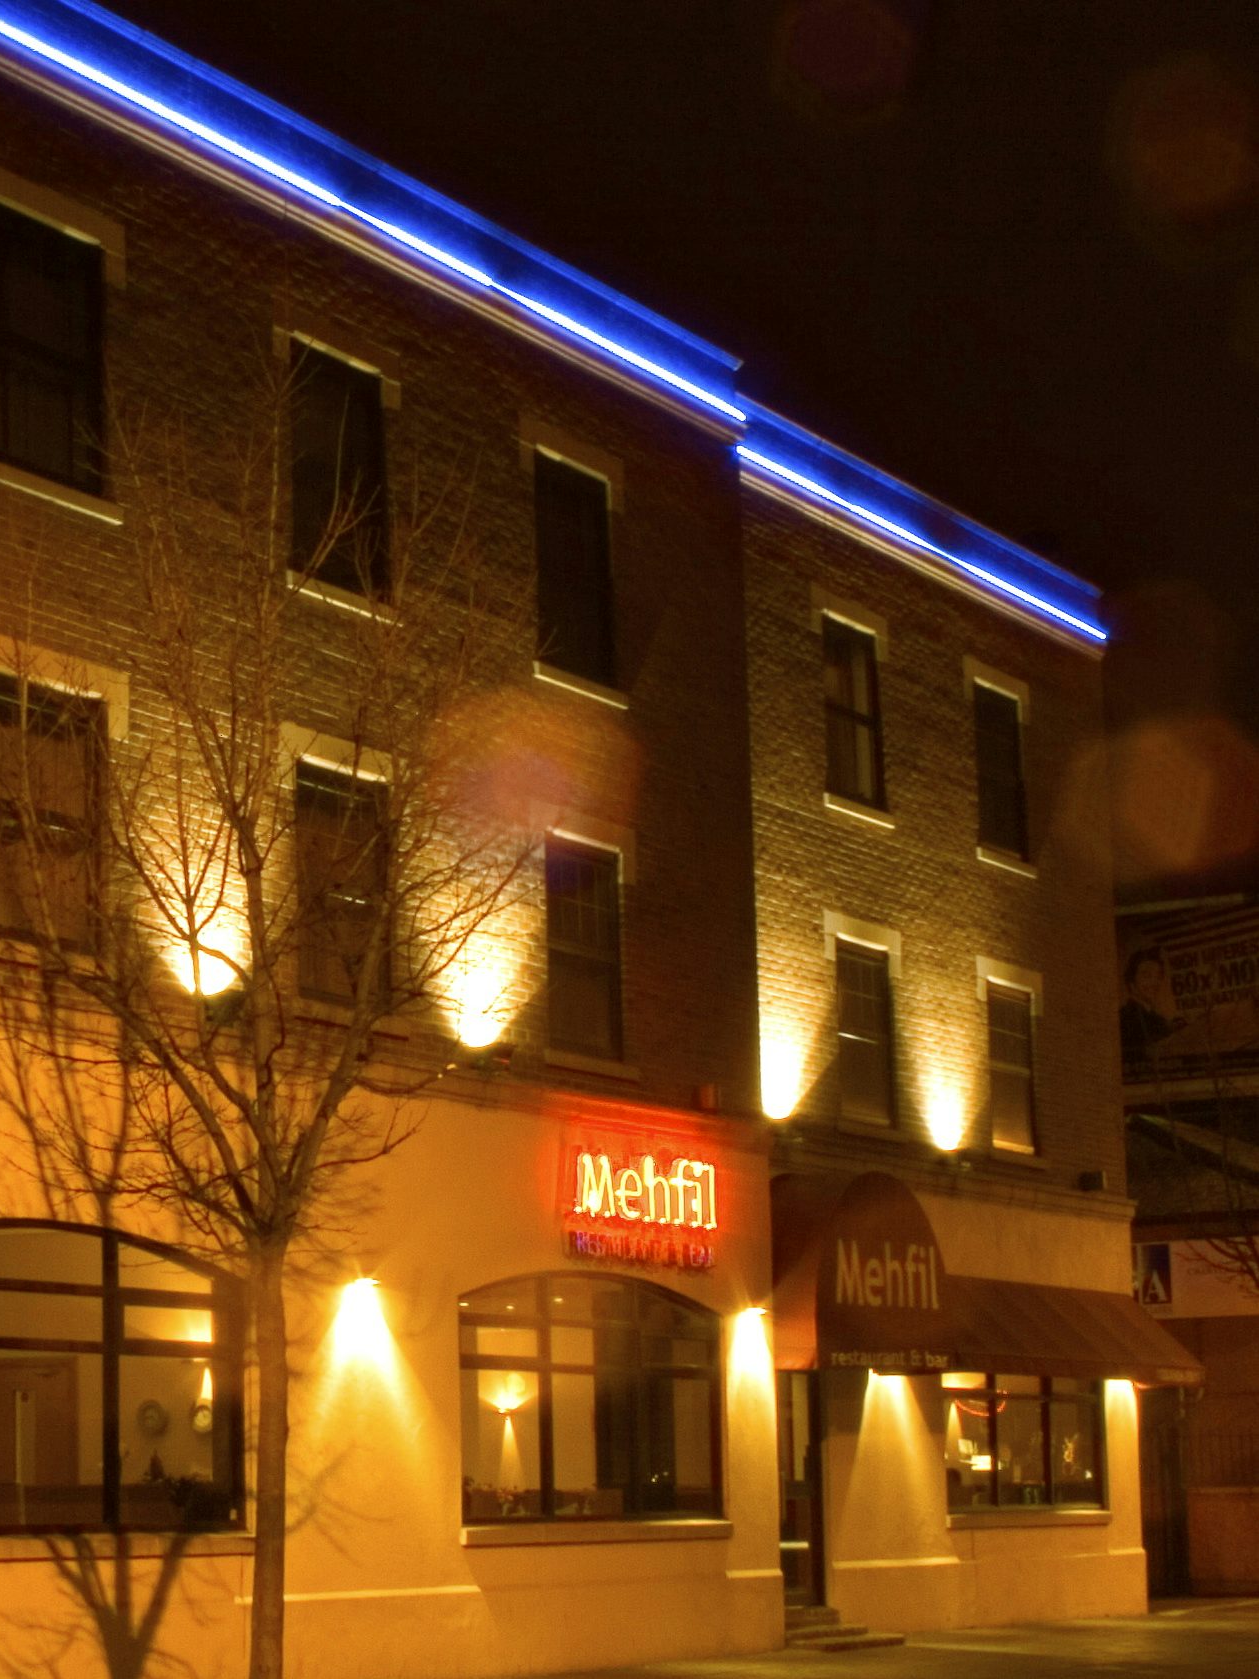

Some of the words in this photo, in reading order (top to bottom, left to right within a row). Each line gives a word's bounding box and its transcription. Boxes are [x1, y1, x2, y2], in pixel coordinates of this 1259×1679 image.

[573, 1153, 717, 1230] Mehfil
[836, 1240, 940, 1310] Mehfil
[831, 1351, 906, 1366] restaurant
[911, 1350, 922, 1366] &
[925, 1351, 949, 1368] bar
